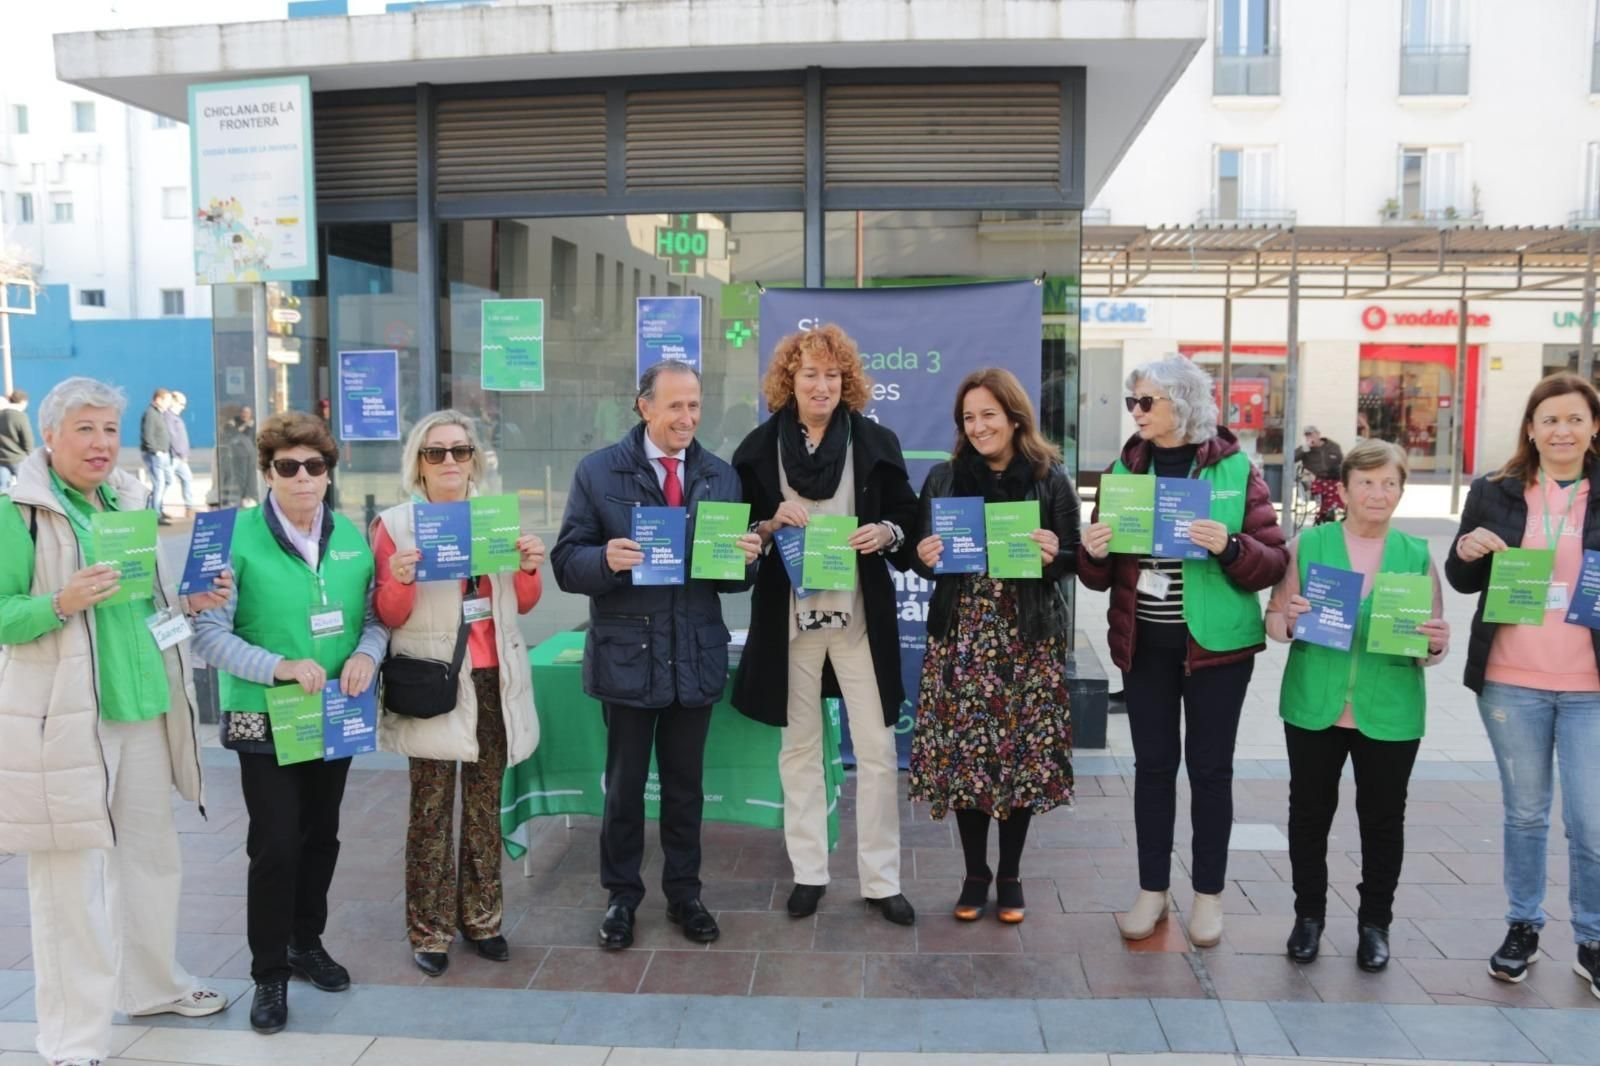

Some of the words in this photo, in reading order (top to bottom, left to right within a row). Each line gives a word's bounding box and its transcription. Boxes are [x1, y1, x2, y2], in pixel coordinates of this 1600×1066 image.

[204, 104, 259, 118] CHICLANA
[262, 102, 276, 113] DE
[280, 101, 294, 112] LA
[220, 116, 279, 130] FRONTERA
[1096, 302, 1146, 322] Cádiz
[1393, 309, 1490, 326] vodafone
[926, 350, 941, 373] 3
[1320, 612, 1344, 622] contra
[1327, 620, 1352, 630] cáncer
